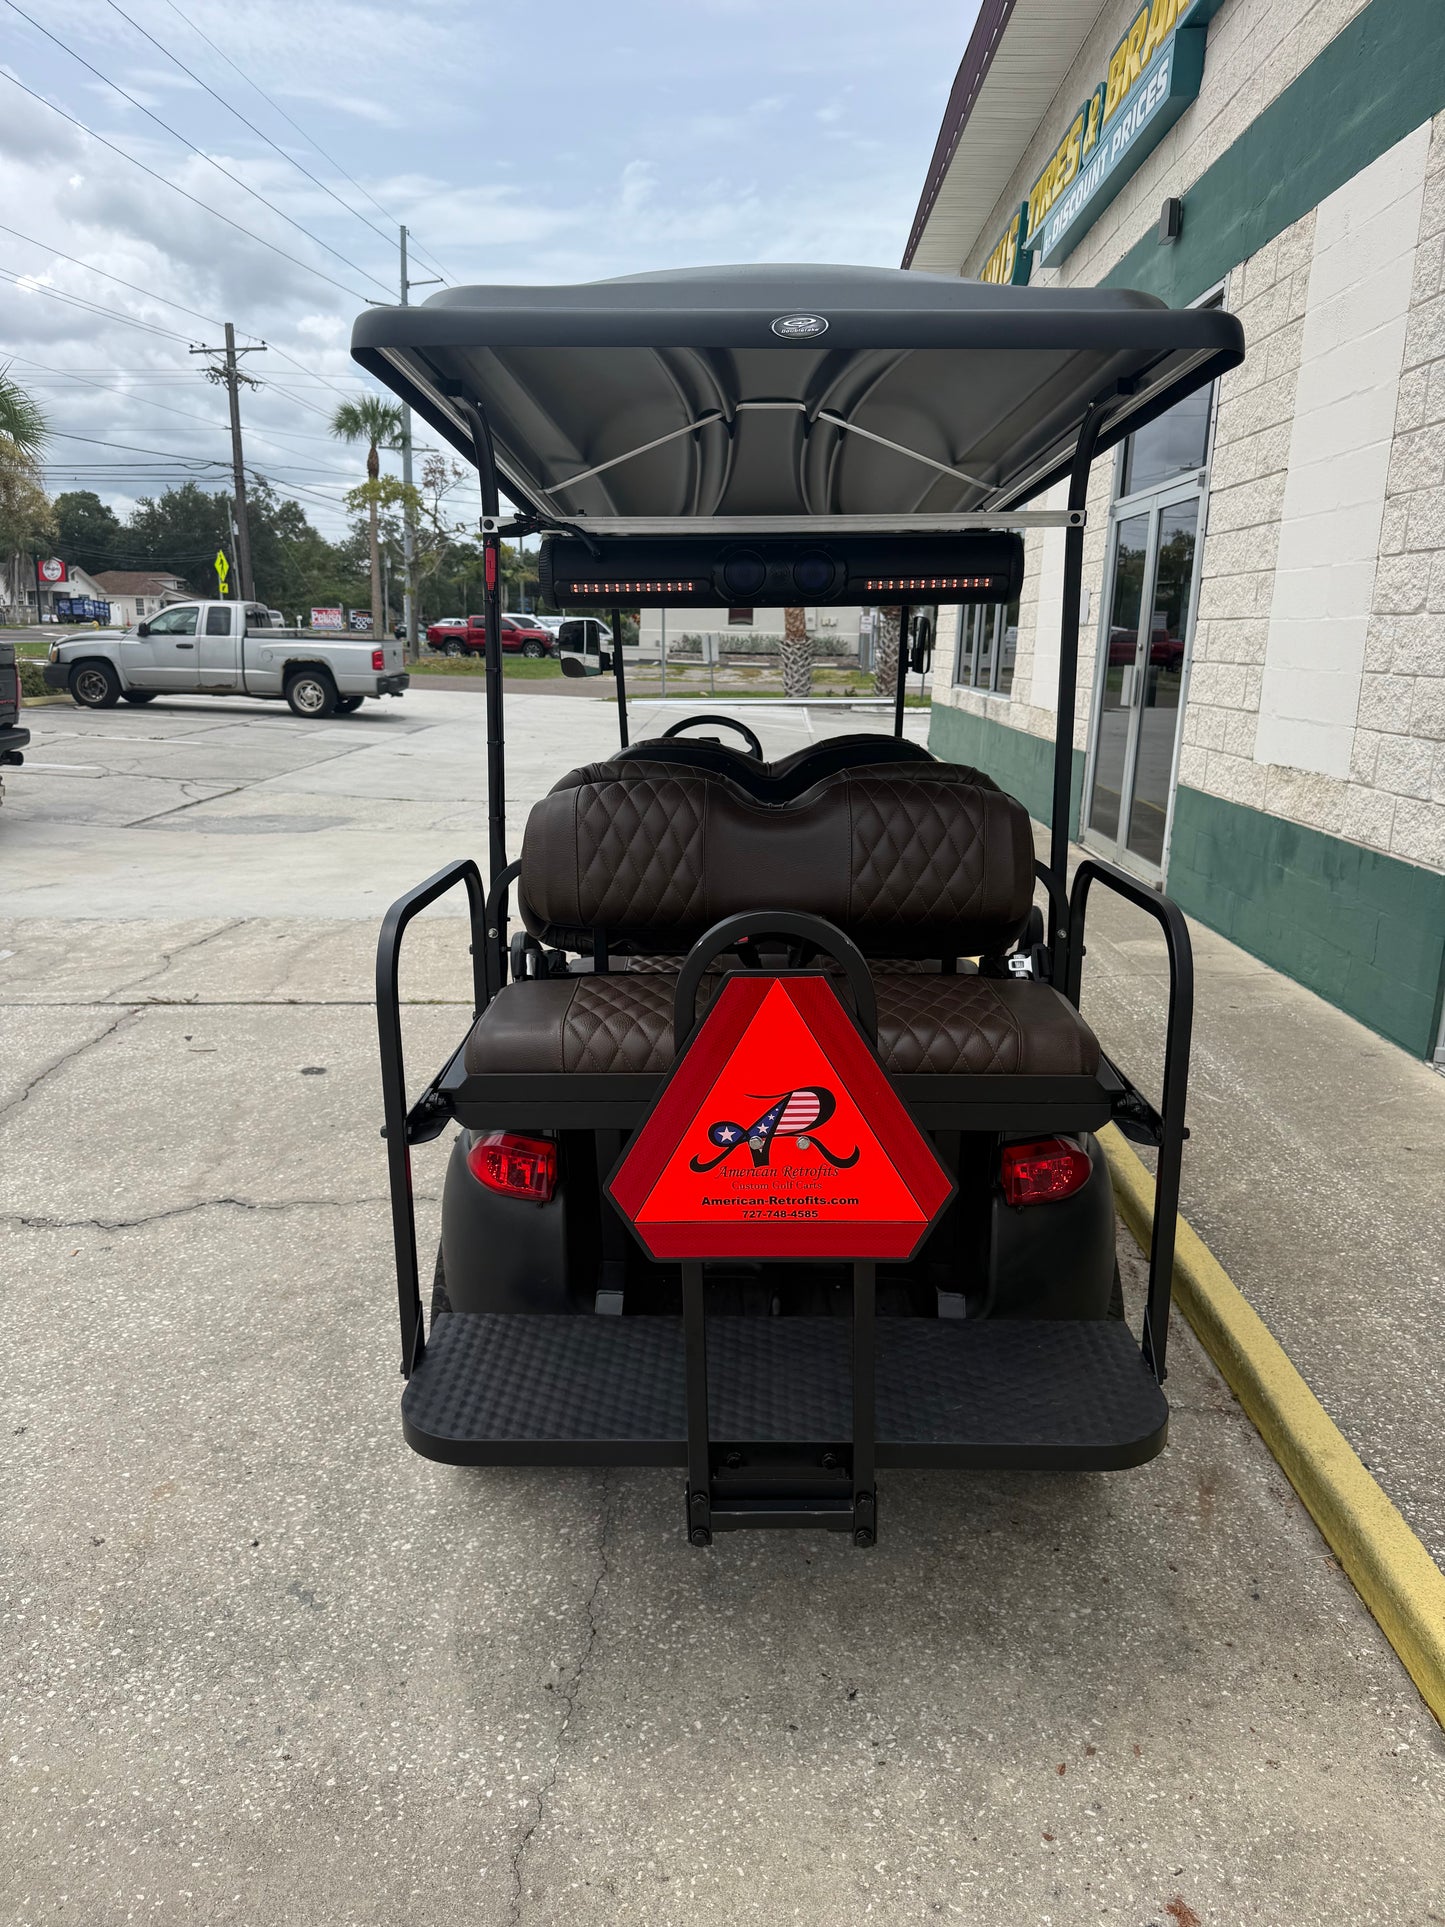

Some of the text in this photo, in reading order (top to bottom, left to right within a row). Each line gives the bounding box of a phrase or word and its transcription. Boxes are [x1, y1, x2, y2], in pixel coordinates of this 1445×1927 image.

[1051, 146, 1110, 243] DISCOUNT
[1110, 57, 1169, 164] PRICES
[1027, 112, 1083, 240] TIRES
[1082, 92, 1100, 155] &
[715, 1163, 839, 1182] American Retrofits
[731, 1180, 822, 1190] Custom Golf Carts
[701, 1195, 859, 1206] American-Retrofits.com
[742, 1210, 819, 1218] 727-748-4585
